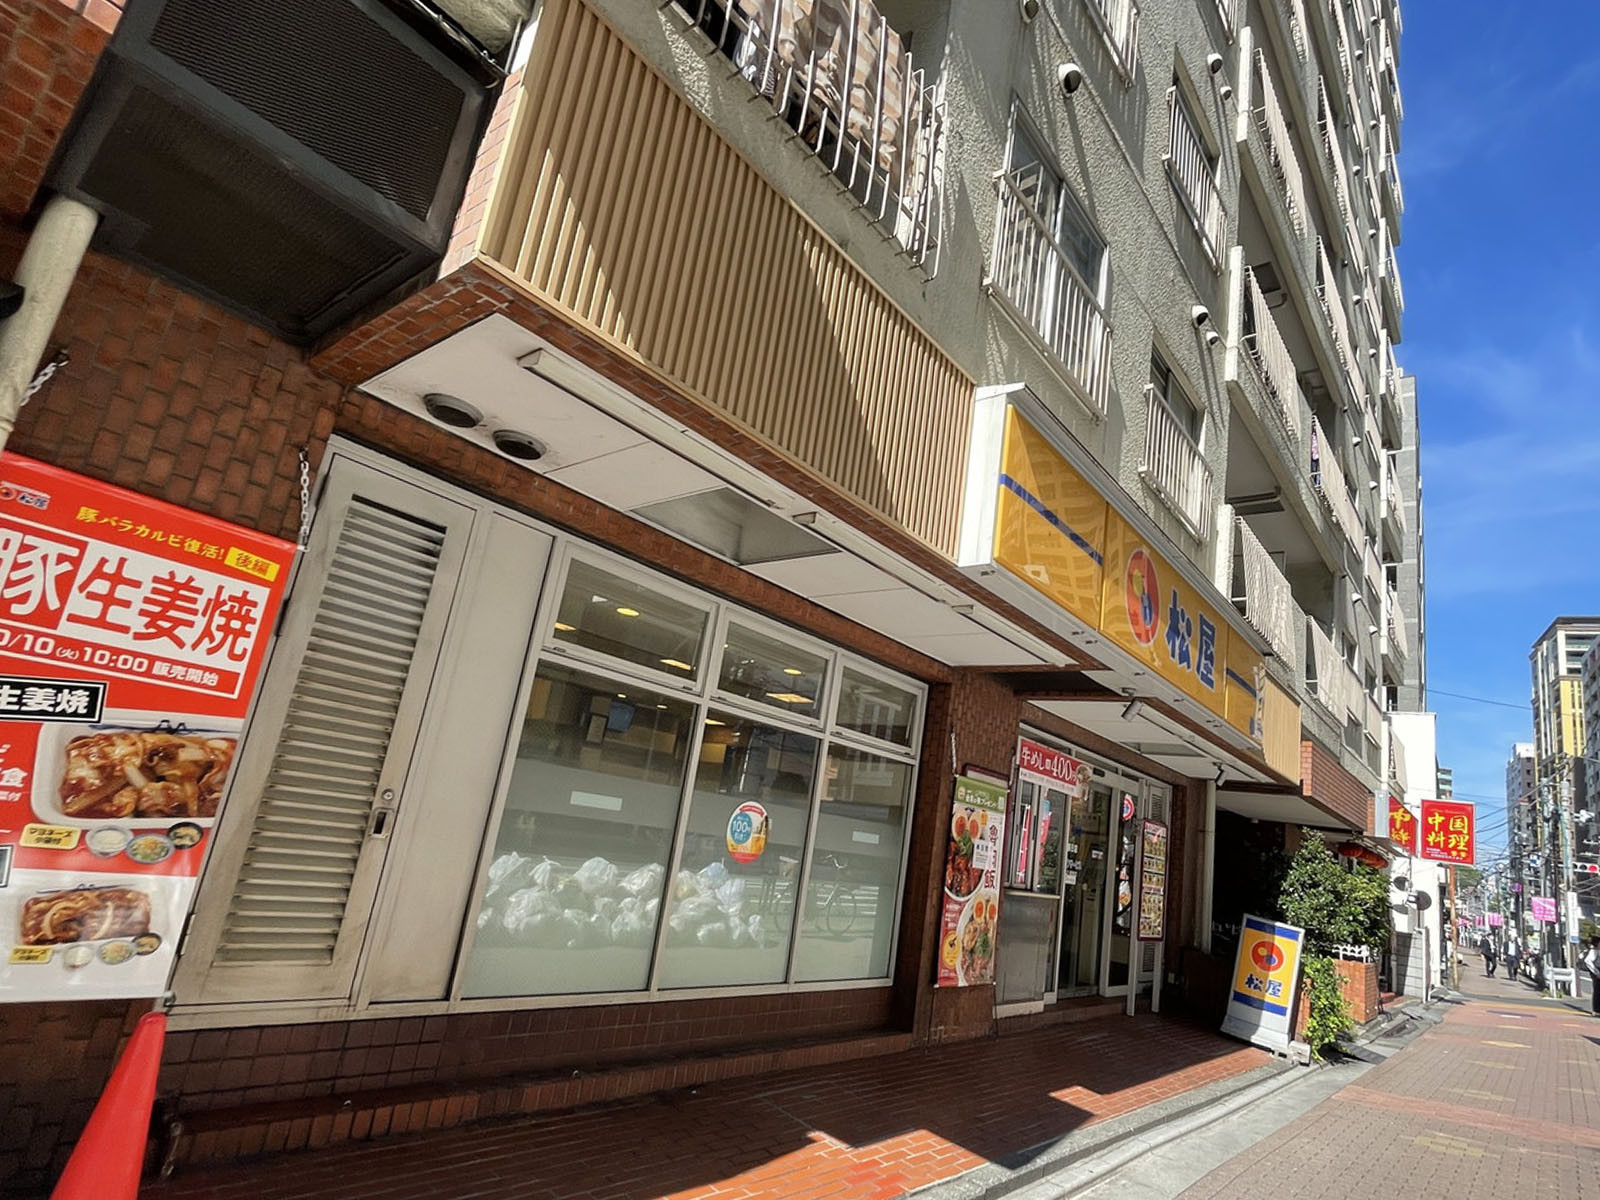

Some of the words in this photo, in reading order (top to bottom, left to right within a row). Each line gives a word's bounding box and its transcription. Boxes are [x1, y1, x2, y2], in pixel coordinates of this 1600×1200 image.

[76, 506, 225, 560] 豚バラカルビ復活!
[235, 552, 271, 577] 後編
[1165, 587, 1216, 690] 松屋
[152, 661, 219, 687] 販売開始
[1427, 810, 1468, 834] 中国
[1426, 831, 1469, 851] 料理
[1244, 973, 1282, 998] 松屋
